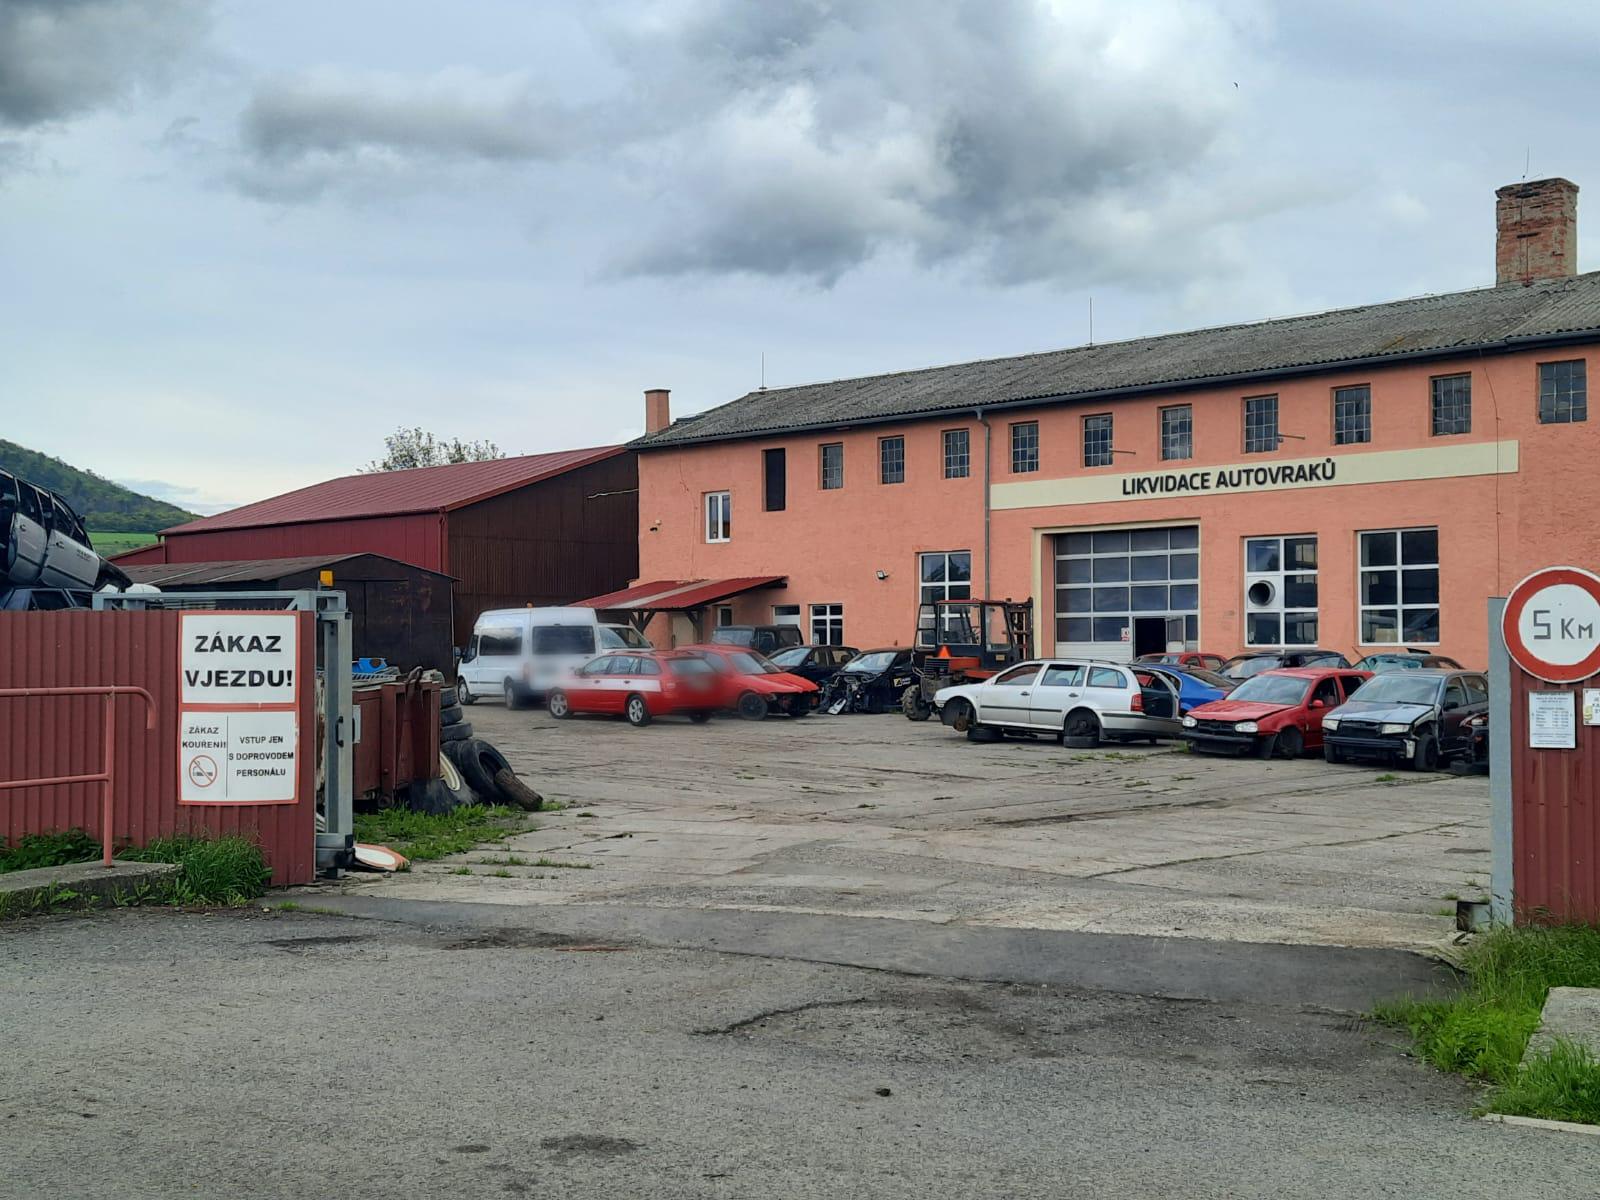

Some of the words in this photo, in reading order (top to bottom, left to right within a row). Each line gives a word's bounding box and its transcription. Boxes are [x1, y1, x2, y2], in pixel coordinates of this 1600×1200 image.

[1122, 472, 1211, 495] LIKVIDACE
[1216, 458, 1336, 488] AUTOVRAKŮ
[1533, 610, 1551, 640] 5
[194, 632, 281, 652] ZÁKAZ
[185, 670, 293, 687] VJEZDU!
[188, 725, 219, 735] ZÁKAZ
[239, 736, 266, 744] VSTUP
[268, 736, 283, 744] JEN
[228, 752, 235, 760] S
[236, 752, 294, 760] DOPROVODEM
[236, 767, 286, 777] PERSONÁLU
